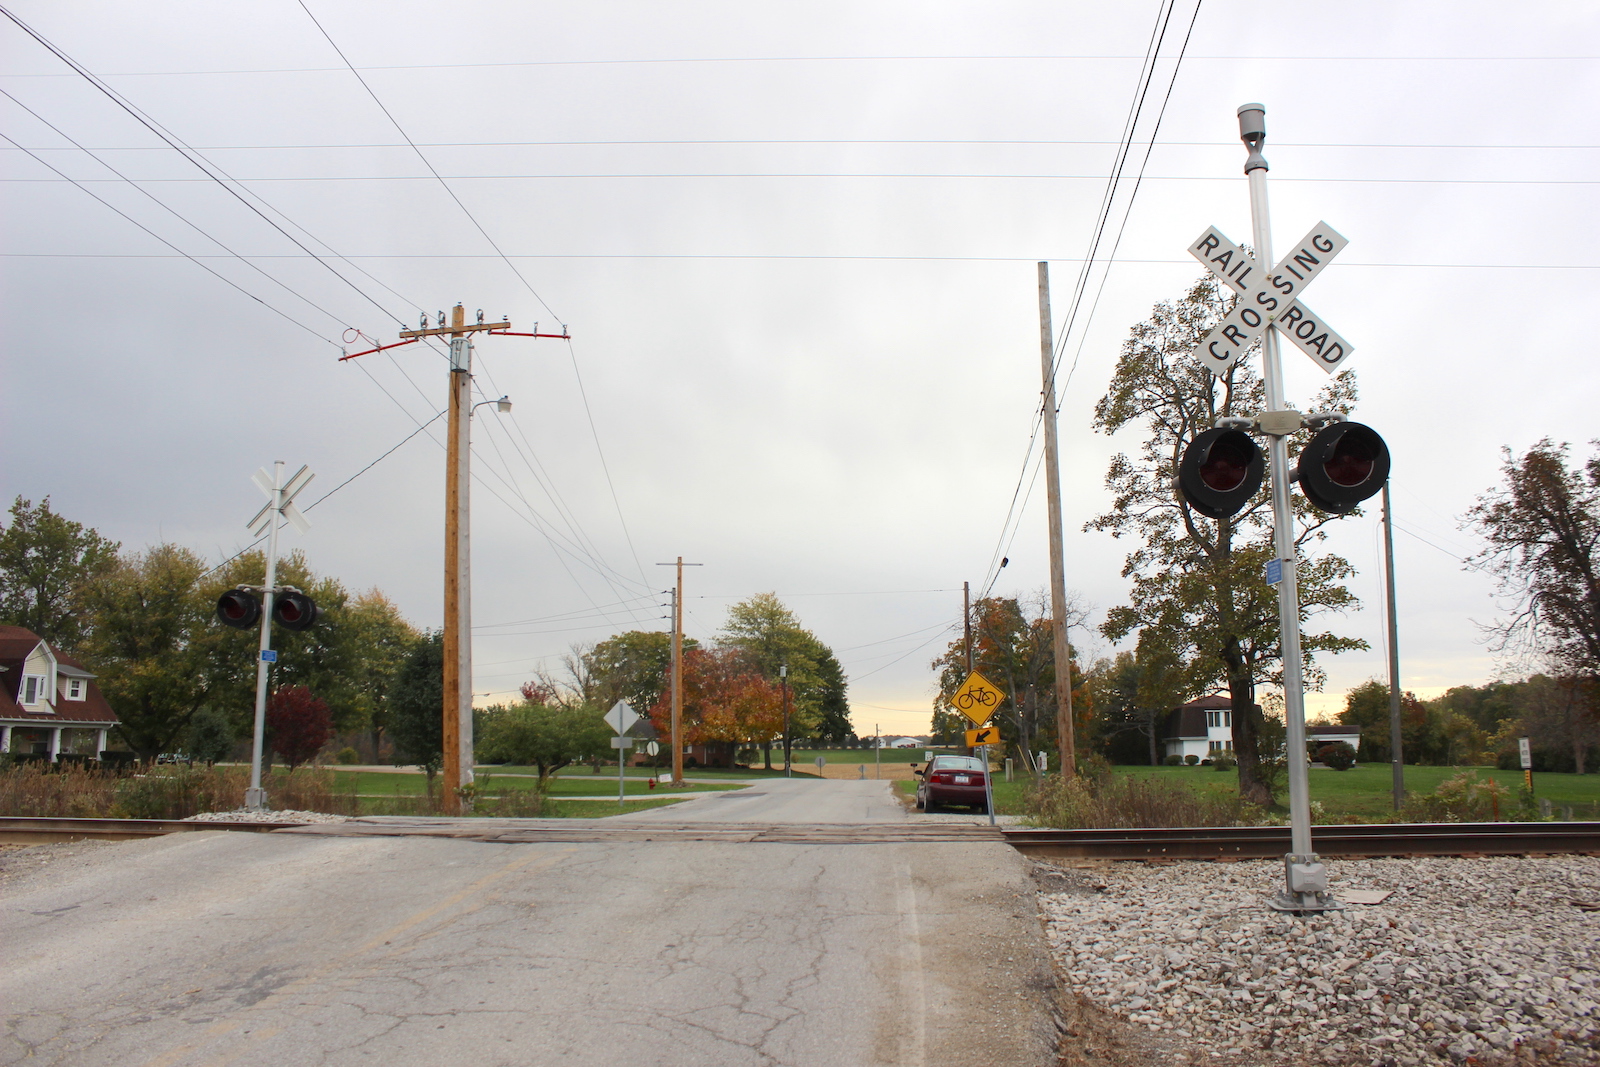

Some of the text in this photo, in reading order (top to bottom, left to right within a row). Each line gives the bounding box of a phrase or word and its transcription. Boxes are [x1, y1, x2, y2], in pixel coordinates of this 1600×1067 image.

[1196, 233, 1344, 364] RAIL ROAD
[1208, 234, 1334, 361] CROSSING
